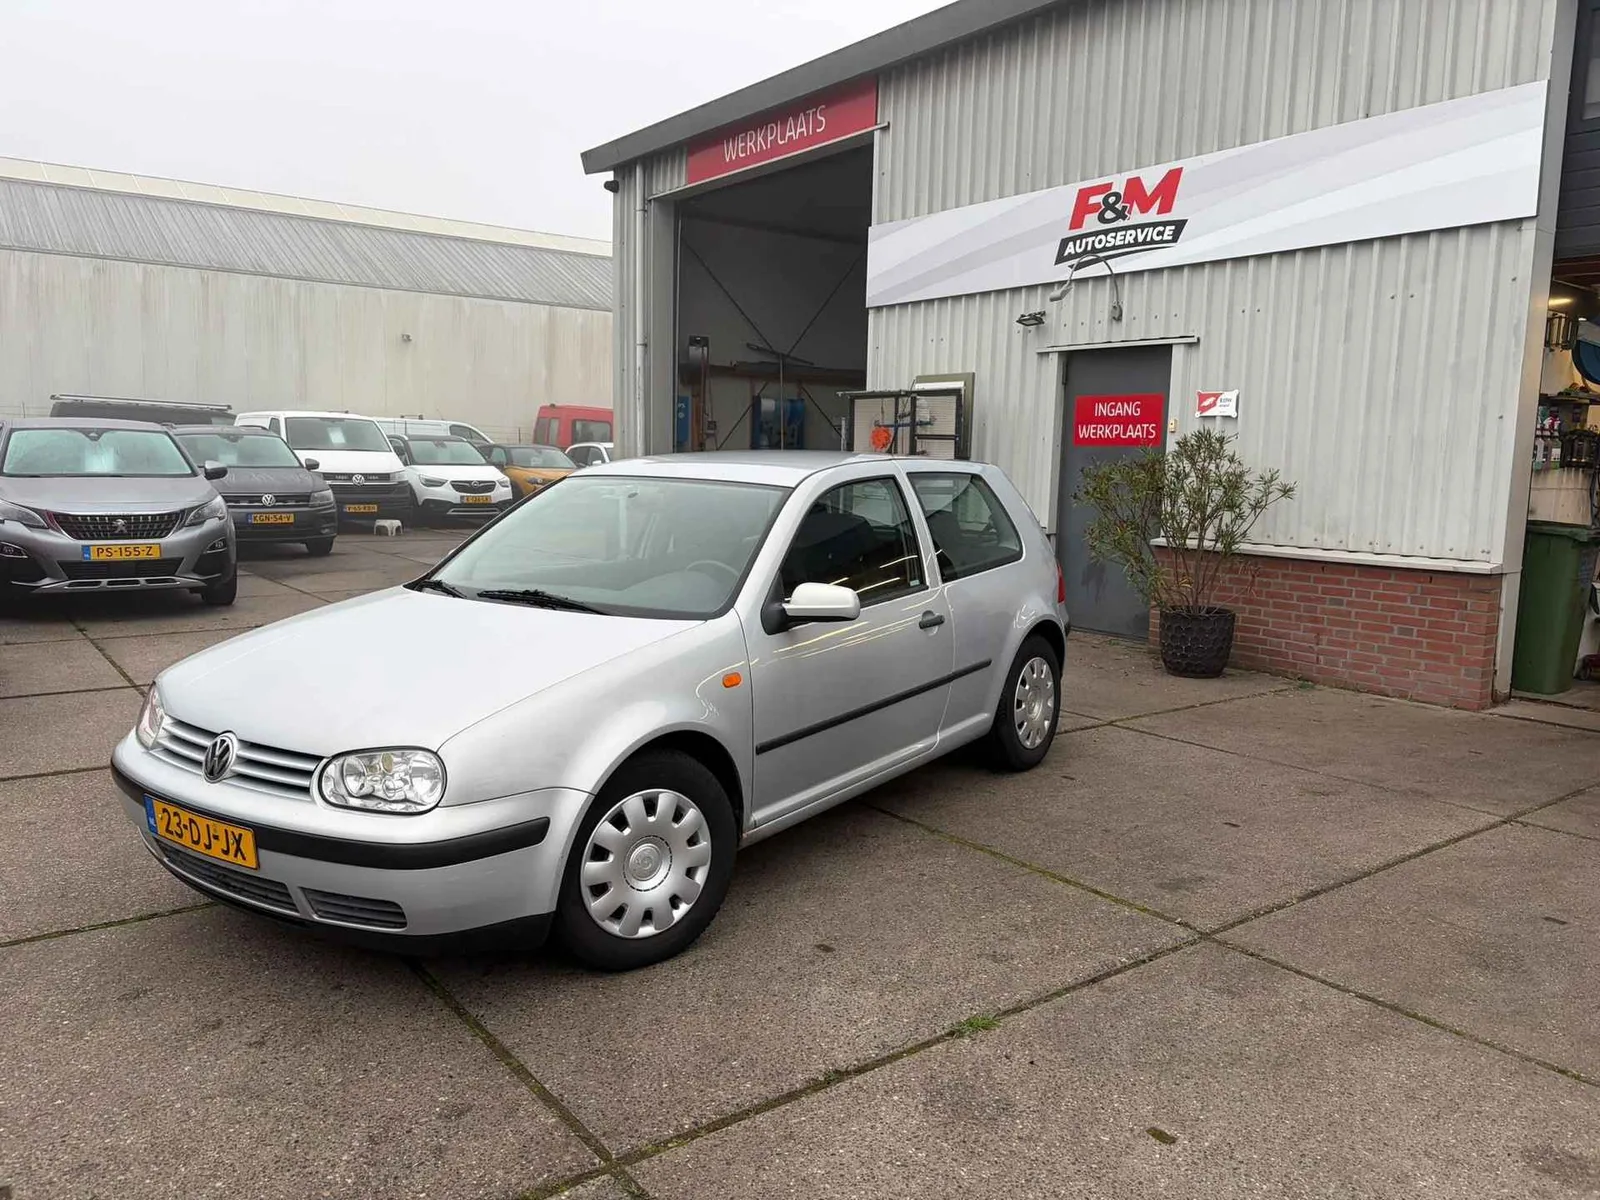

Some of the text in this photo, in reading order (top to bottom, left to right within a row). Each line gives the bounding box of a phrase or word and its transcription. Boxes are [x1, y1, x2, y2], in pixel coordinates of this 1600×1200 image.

[723, 105, 826, 162] WERKPLAATS
[1068, 166, 1184, 231] F&M
[1063, 225, 1176, 257] AUTOSERVICE
[1094, 401, 1141, 417] INGANG
[1078, 423, 1156, 439] WERKPLAATS
[253, 514, 291, 522] KGN-54-V
[96, 546, 154, 557] PS-155-Z
[162, 807, 247, 861] 23-DJ-JX
